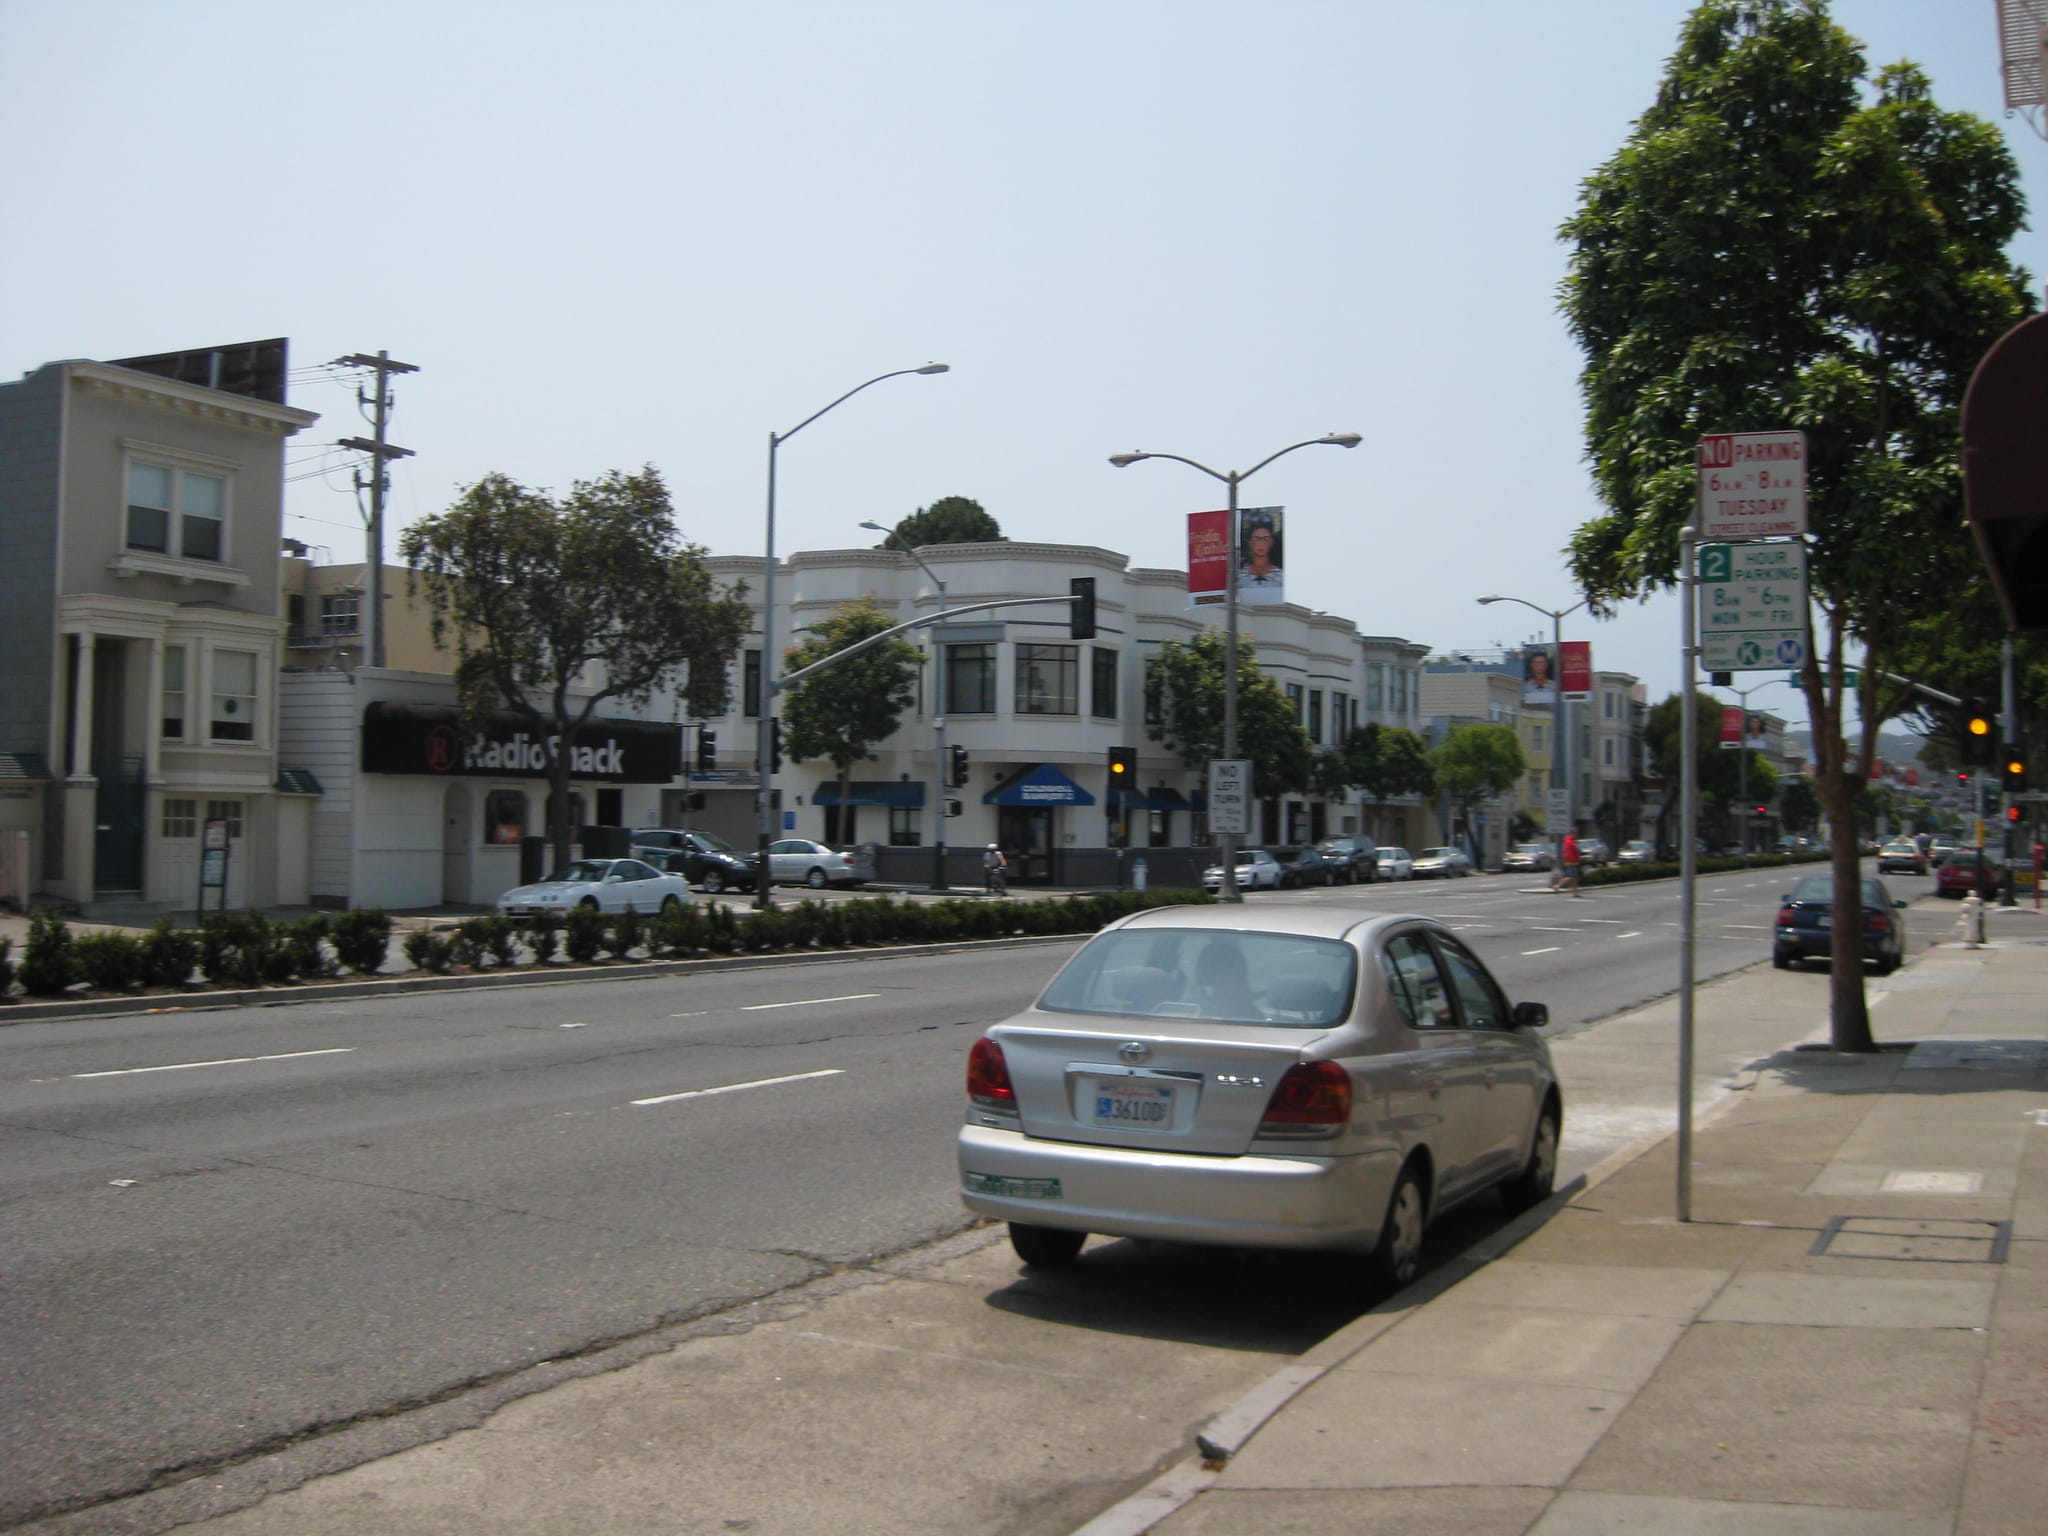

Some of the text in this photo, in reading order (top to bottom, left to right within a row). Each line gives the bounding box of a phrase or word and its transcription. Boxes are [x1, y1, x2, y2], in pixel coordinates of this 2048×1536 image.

[1701, 439, 1801, 465] NO PARKING
[1718, 498, 1787, 516] TUESDAY
[1706, 551, 1726, 577] 2
[1744, 551, 1786, 565] HOUR
[1735, 566, 1799, 580] PARKING
[1772, 609, 1793, 622] FRI
[1218, 765, 1238, 777] NO
[1216, 781, 1240, 791] LEFT
[1215, 794, 1240, 804] TURN
